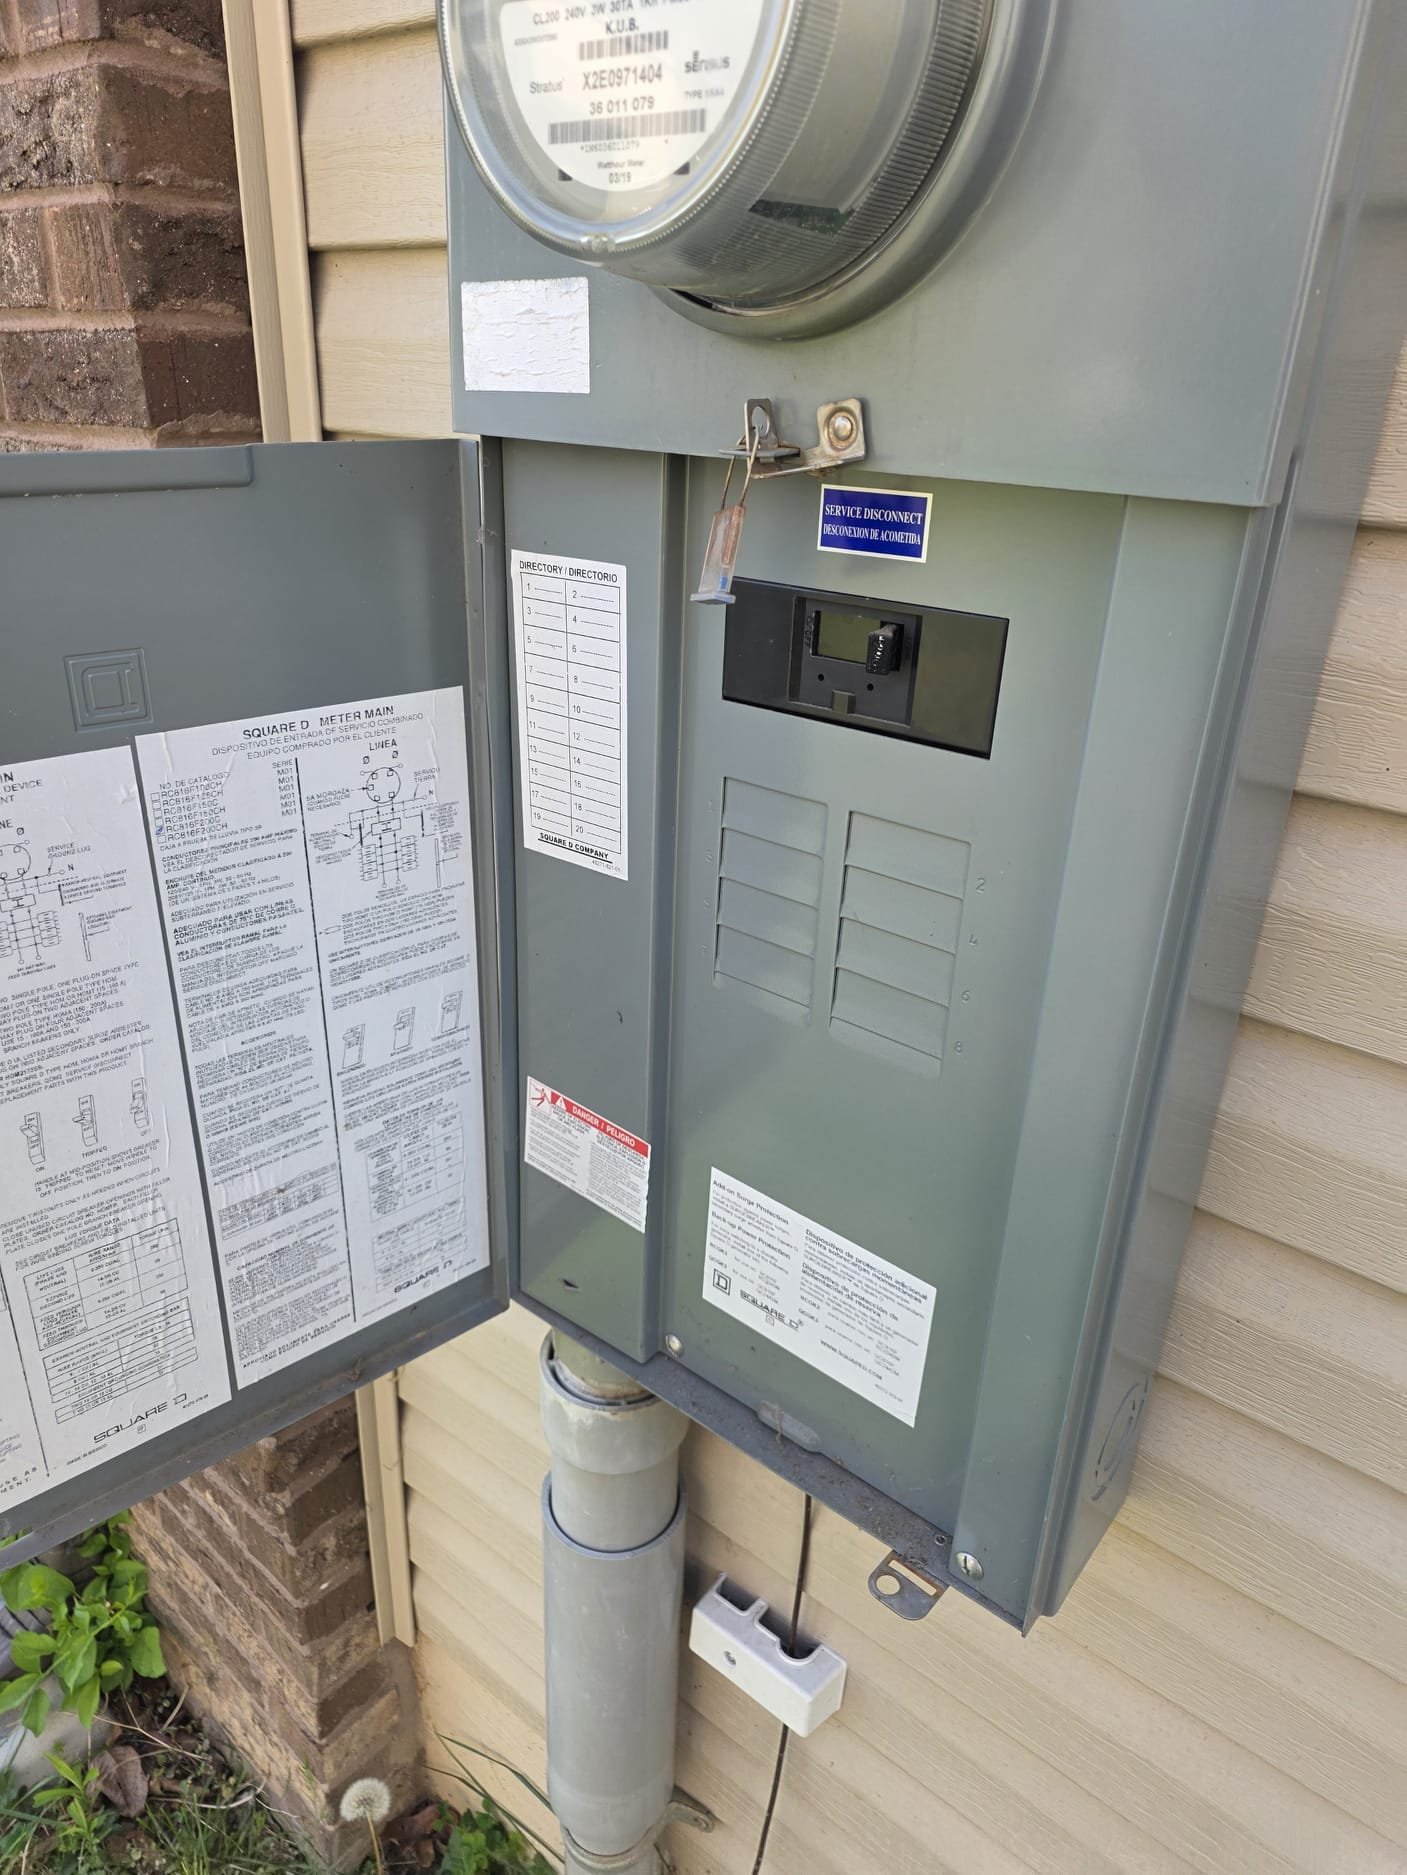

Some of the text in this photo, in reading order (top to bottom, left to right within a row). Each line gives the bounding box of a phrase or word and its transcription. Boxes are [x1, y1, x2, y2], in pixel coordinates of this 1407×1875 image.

[565, 8, 586, 21] 240V
[592, 5, 605, 16] 3W
[606, 17, 639, 34] K.U.B.
[530, 81, 562, 94] Stratus
[582, 64, 662, 91] X2E0971404
[590, 96, 654, 115] 36 011 079
[825, 504, 922, 524] SERVICE DISCONNECT
[823, 523, 920, 544] DESCONEXION DE ACOMETIDA
[520, 561, 562, 574] DIRECTORY
[569, 567, 617, 583] DIRECTORIO
[527, 607, 531, 615] 3
[573, 705, 580, 713] 10
[243, 706, 393, 739] SQUARE D METER MAIN
[529, 721, 581, 740] 11 12
[212, 739, 267, 755] DISPOSITIVO
[339, 721, 375, 732] SERVICIO
[378, 713, 422, 726] COMBINADO
[247, 747, 279, 759] EQUIPO
[283, 739, 330, 752] COMPRADO
[333, 735, 349, 743] POR
[364, 727, 396, 738] CLIENTE
[369, 738, 396, 750] LINEA
[272, 759, 292, 768] SERIE
[530, 745, 581, 765] 13 14
[277, 767, 292, 775] M01
[278, 775, 293, 784] M01
[531, 768, 581, 788] 15 16
[5, 779, 42, 792] DEVICE
[279, 784, 293, 792] M01
[280, 792, 294, 800] M01
[280, 800, 295, 808] M01
[532, 790, 582, 811] 17 18
[281, 808, 296, 816] M01
[533, 812, 583, 833] 19 20
[540, 832, 566, 846] SQUARE
[575, 843, 608, 858] COMPANY
[68, 863, 73, 871] N
[976, 877, 985, 894] 2
[572, 1105, 598, 1126] DANGER
[606, 1124, 634, 1147] PELIGRO
[756, 1202, 788, 1226] Protection
[738, 1225, 756, 1241] Power
[758, 1236, 790, 1260] Protection
[805, 1228, 842, 1255] Dispositivo
[394, 1266, 438, 1293] SQUARE
[740, 1289, 784, 1322] SQUARE
[94, 1392, 186, 1445] SQUARE D
